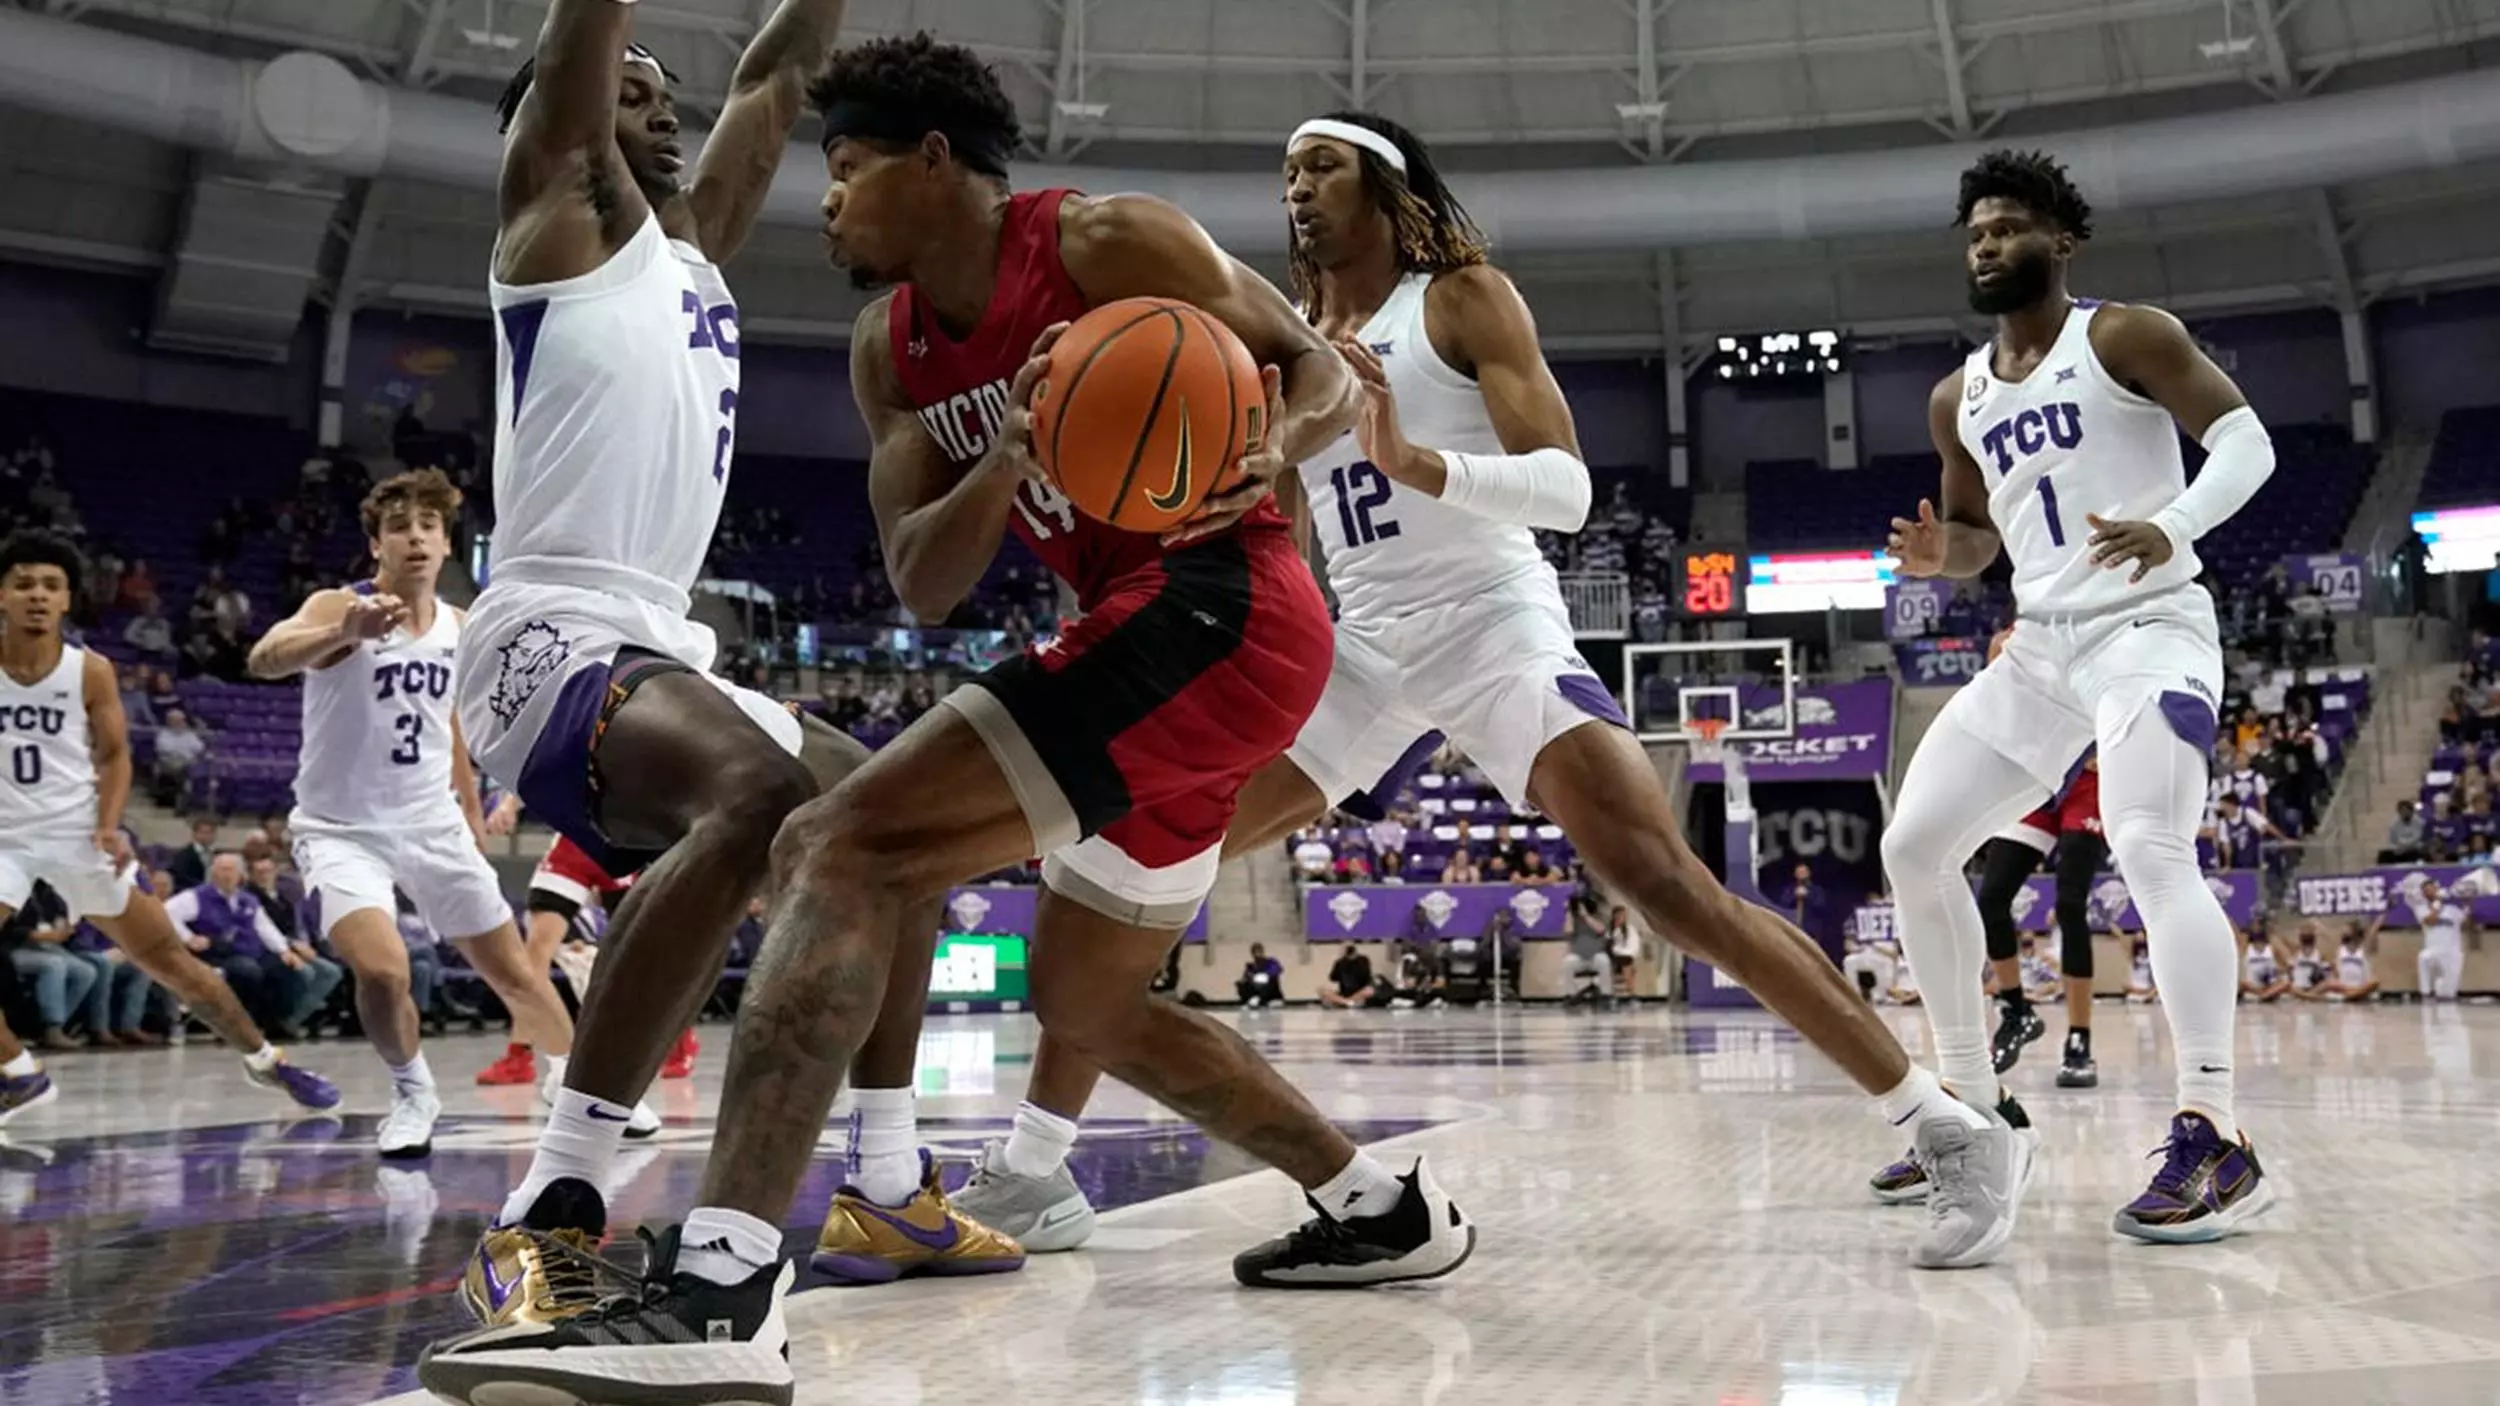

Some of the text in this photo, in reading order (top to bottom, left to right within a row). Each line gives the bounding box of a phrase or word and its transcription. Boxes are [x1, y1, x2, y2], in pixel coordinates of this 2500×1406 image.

[1982, 402, 2083, 477] TCU
[1330, 460, 1401, 548] 12
[2037, 475, 2065, 547] 1
[1686, 575, 1731, 613] 20
[2318, 570, 2355, 598] 04
[1900, 596, 1935, 622] 09
[374, 661, 450, 701] TCU
[1916, 651, 1984, 680] TCU
[391, 713, 422, 765] 3
[1750, 734, 1877, 755] OCKET
[13, 744, 41, 785] 0
[1758, 808, 1870, 867] TCU
[2300, 876, 2387, 914] DEFENSE
[1857, 907, 1898, 940] DEF
